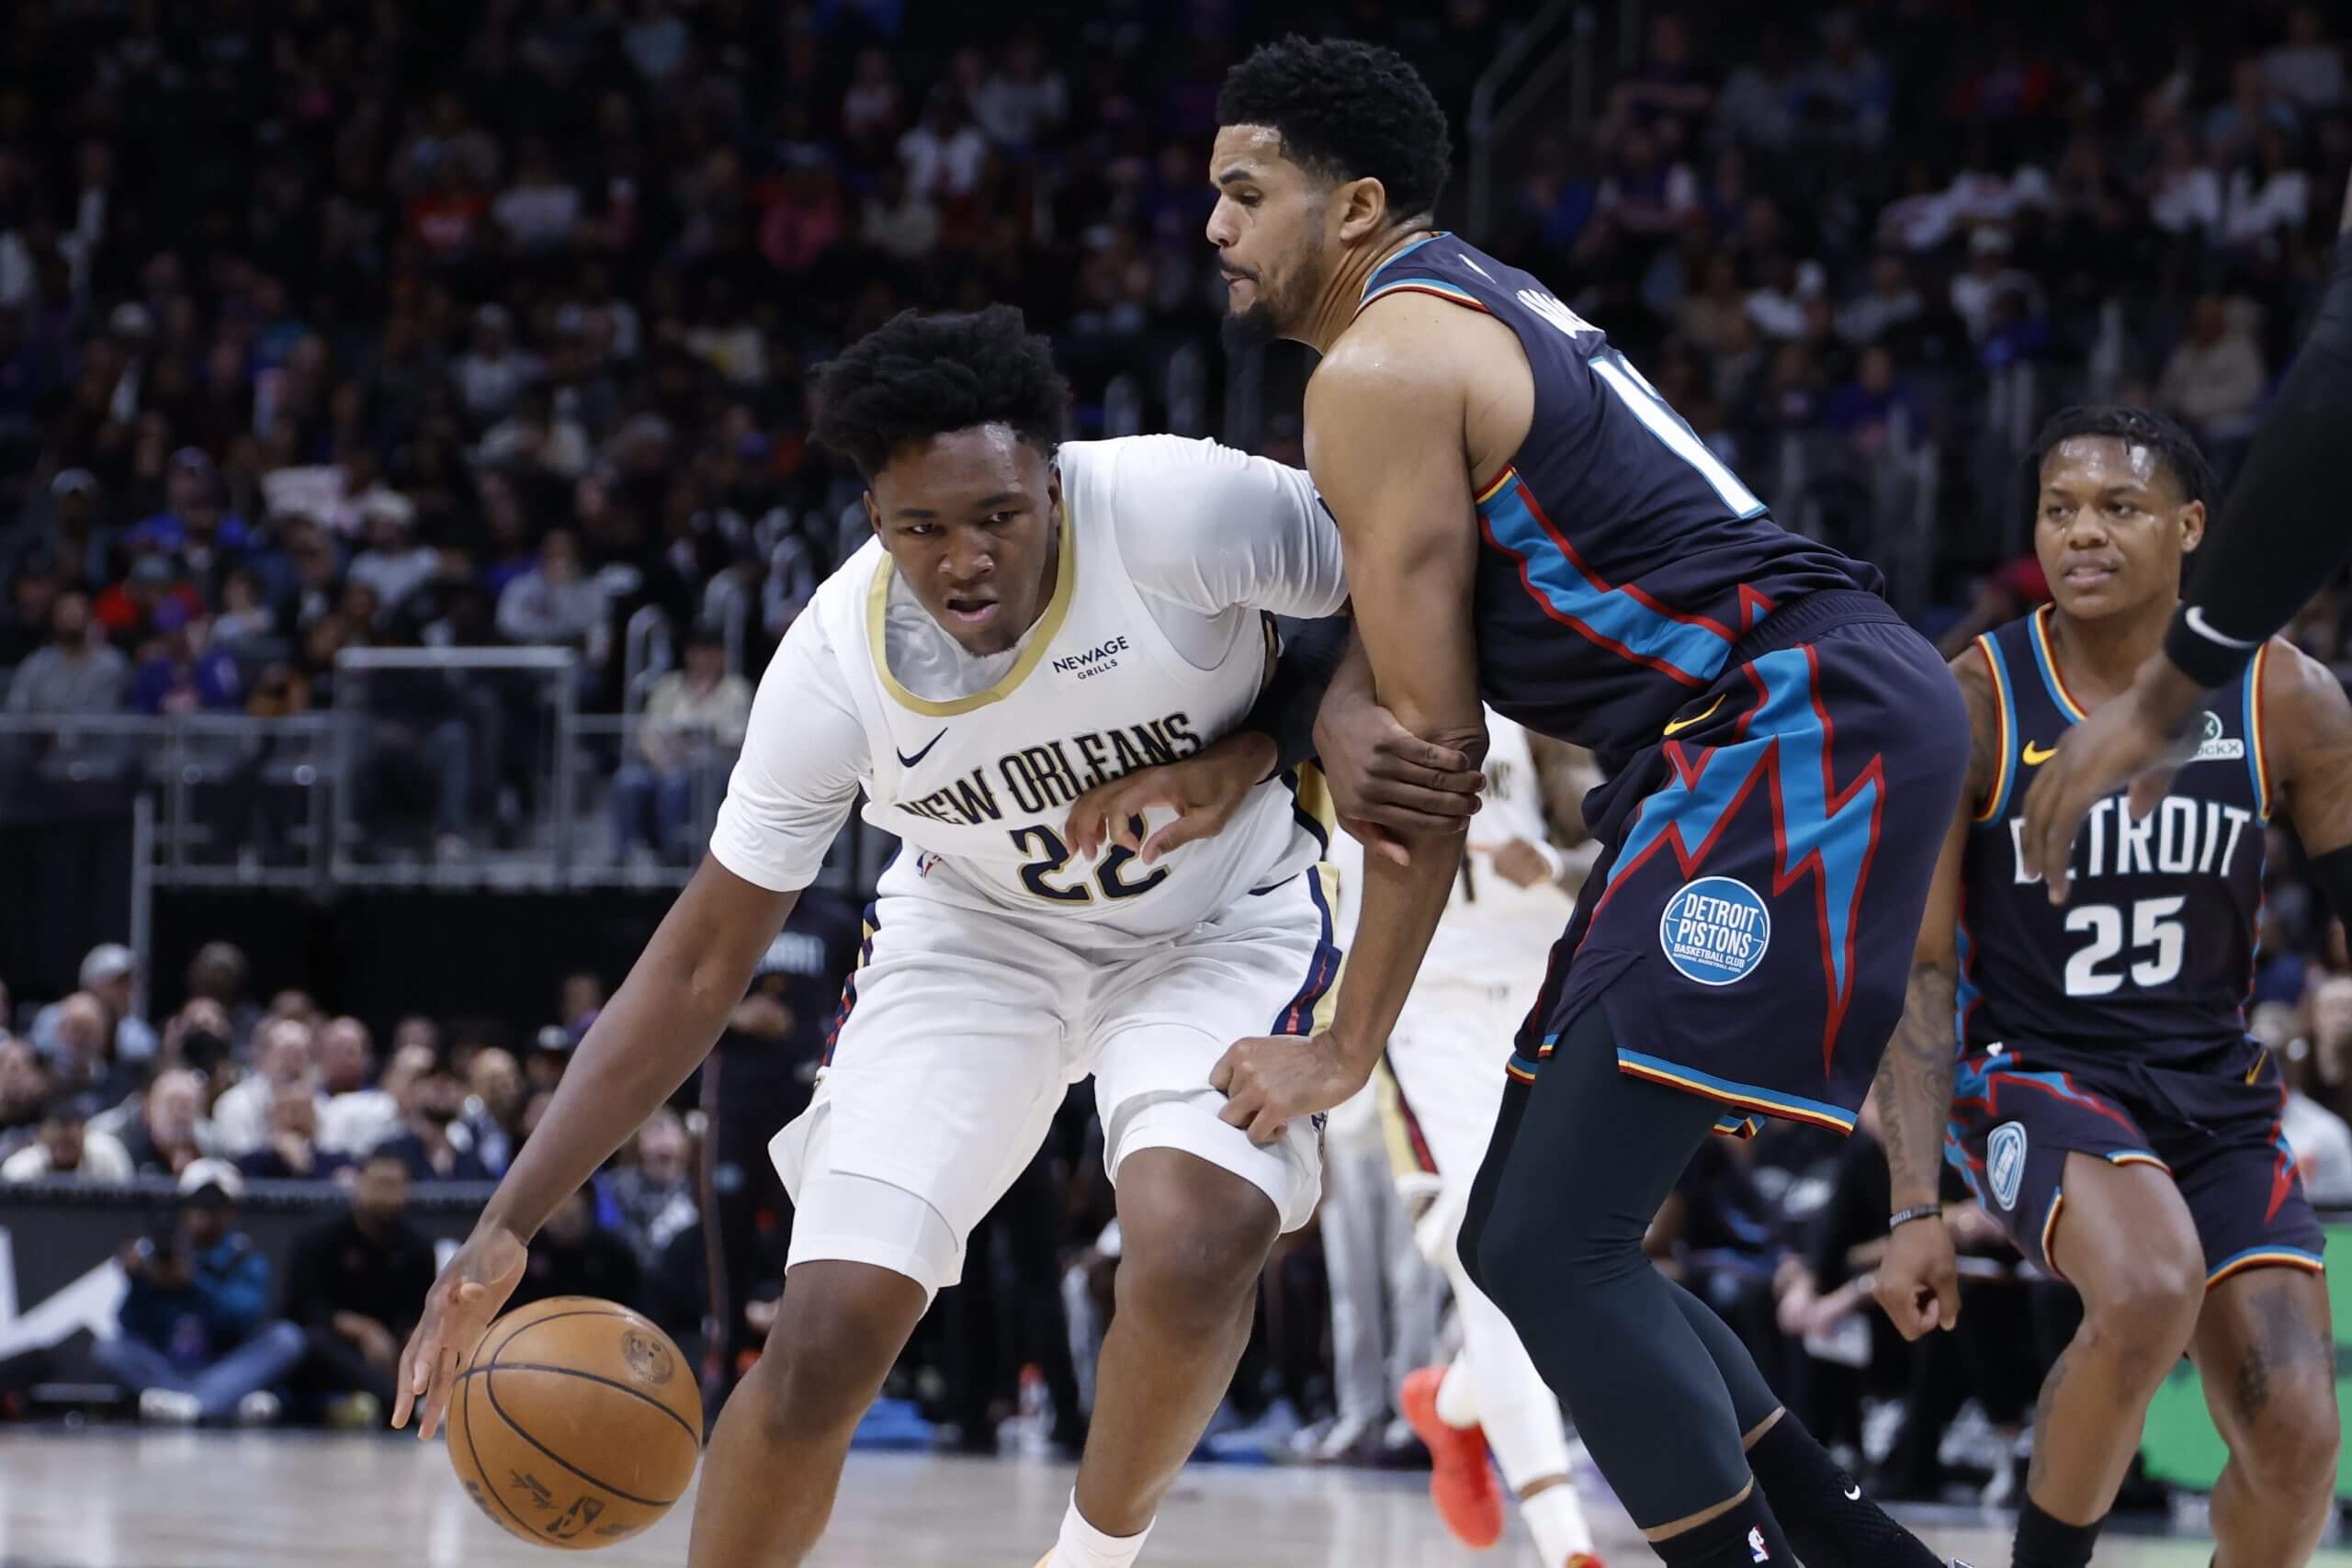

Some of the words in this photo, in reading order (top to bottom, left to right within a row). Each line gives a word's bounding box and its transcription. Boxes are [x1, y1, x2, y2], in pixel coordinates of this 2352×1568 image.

[1588, 353, 1767, 519] 1
[1052, 636, 1129, 673] NEWAGE
[1078, 659, 1118, 680] GRILLS
[894, 765, 1004, 825] NEW
[999, 712, 1202, 814] ORLEANS
[2009, 795, 2252, 884] DTROIT
[1683, 893, 1759, 931] DETROIT
[1673, 943, 1724, 964] BASKETBALL
[1725, 955, 1746, 969] CLUB
[1677, 919, 1752, 958] PISTONS
[2064, 896, 2188, 997] 25
